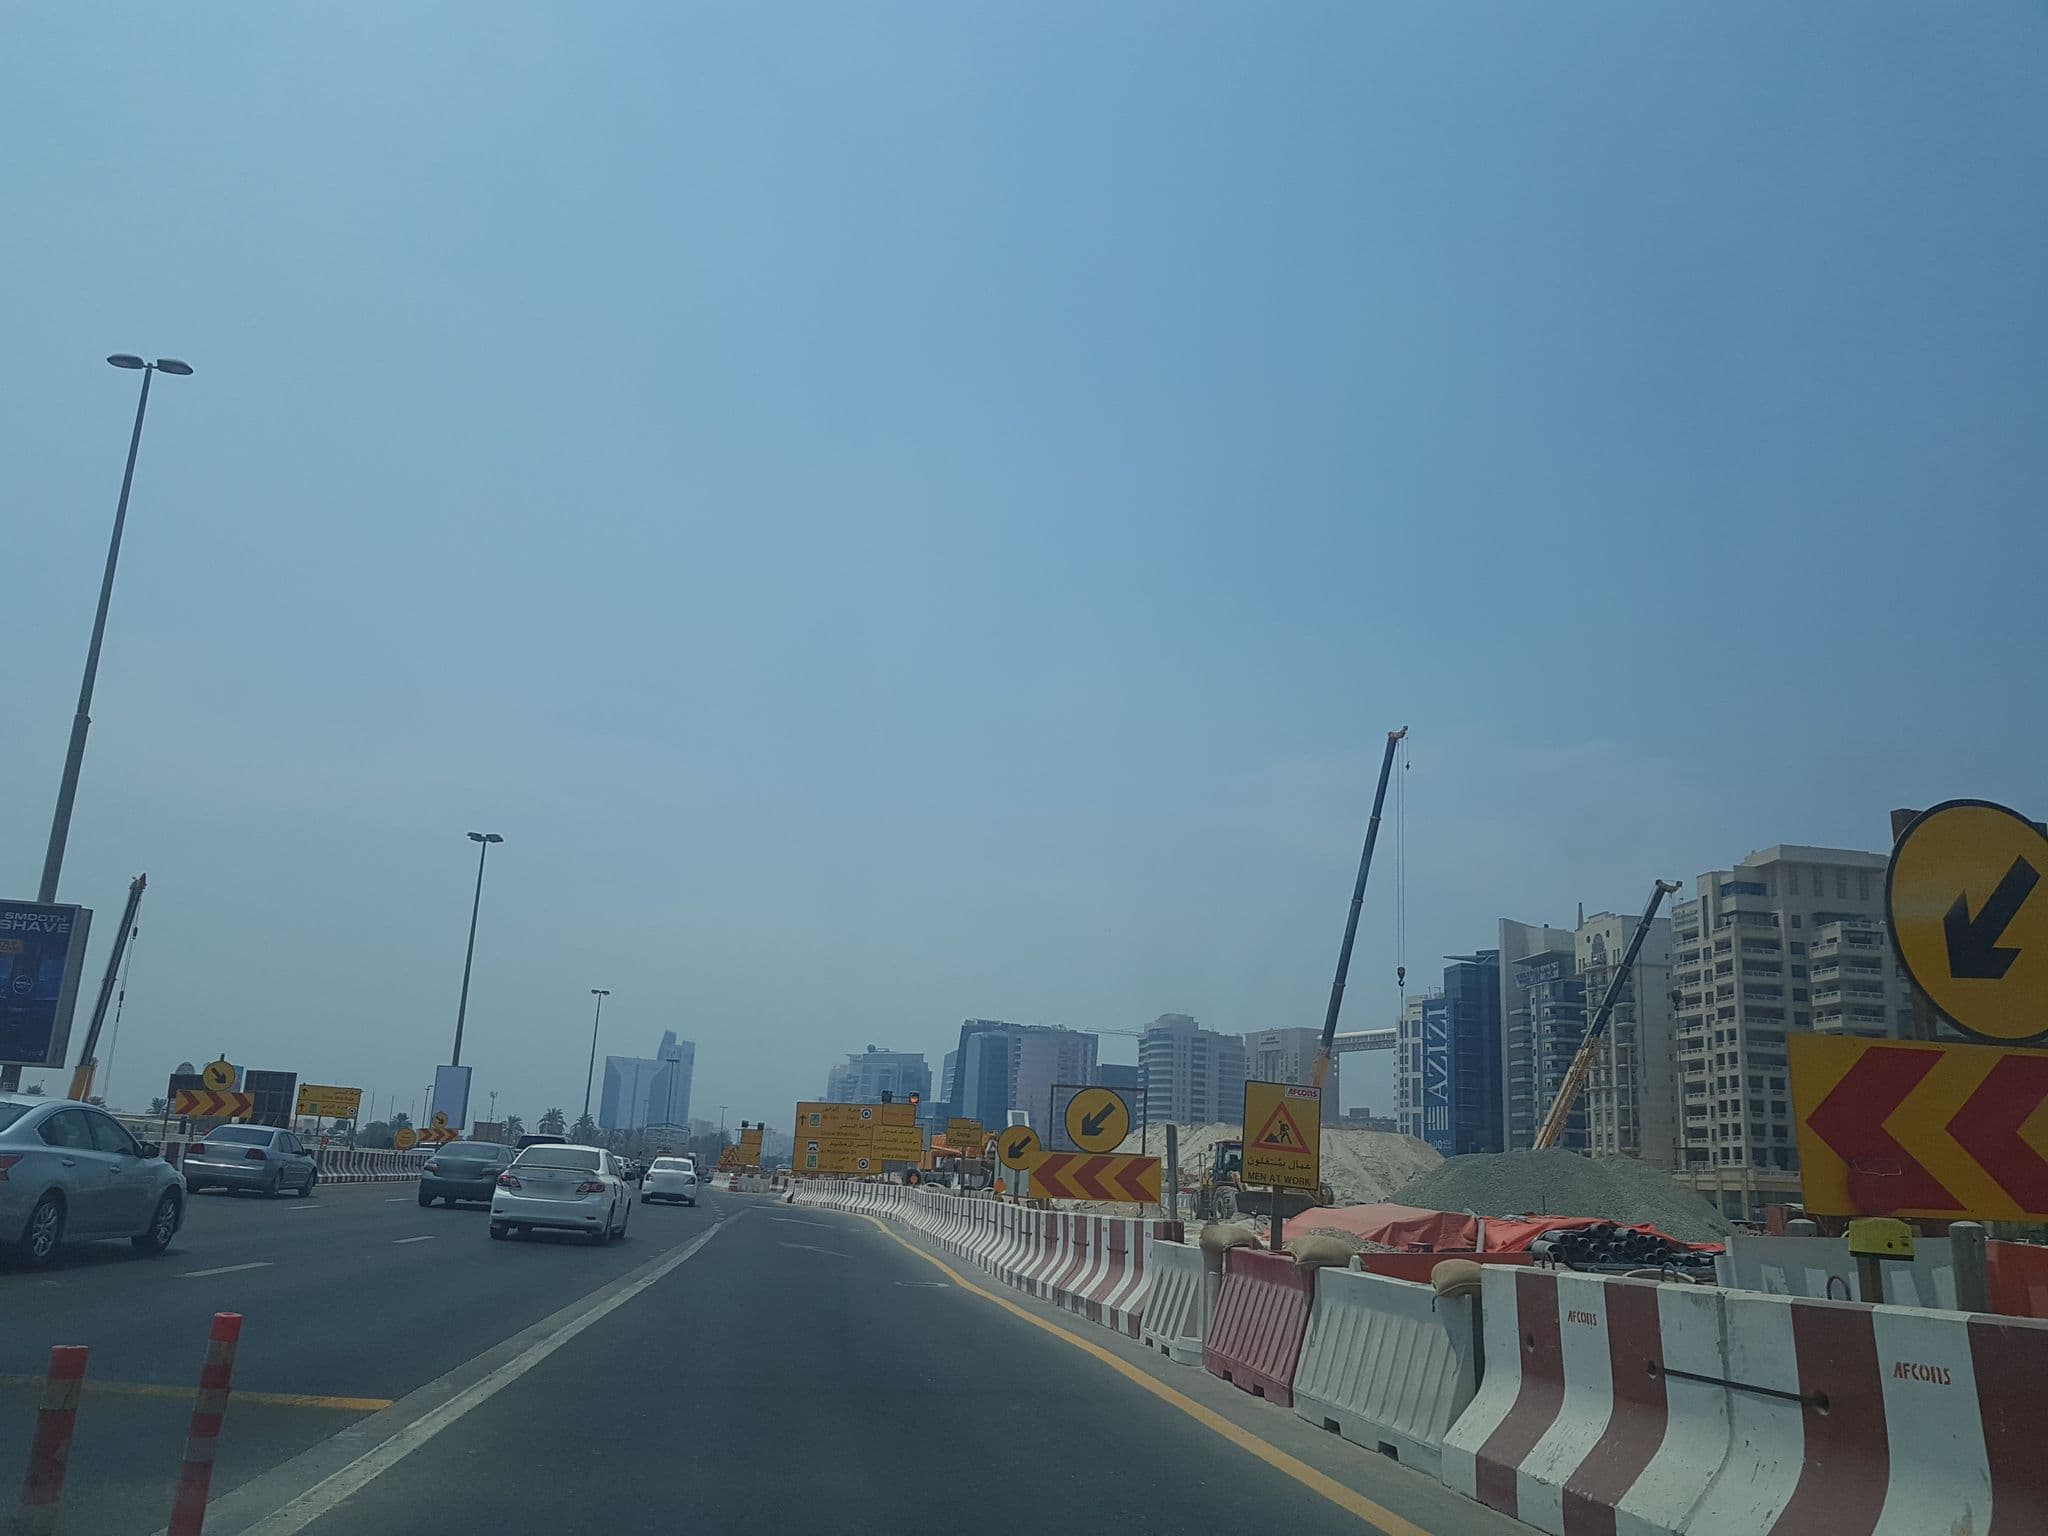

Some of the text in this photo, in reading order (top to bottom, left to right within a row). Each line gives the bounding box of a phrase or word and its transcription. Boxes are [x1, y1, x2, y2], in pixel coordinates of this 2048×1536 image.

[4, 911, 67, 923] SMOOTH
[0, 919, 71, 933] SHAVE
[1427, 1005, 1449, 1104] AZIZI
[1287, 1087, 1318, 1098] AFCONS
[1247, 1172, 1312, 1187] MEN AT WORK
[1567, 1310, 1597, 1326] AFCONS
[1893, 1361, 1952, 1386] AFCONS
